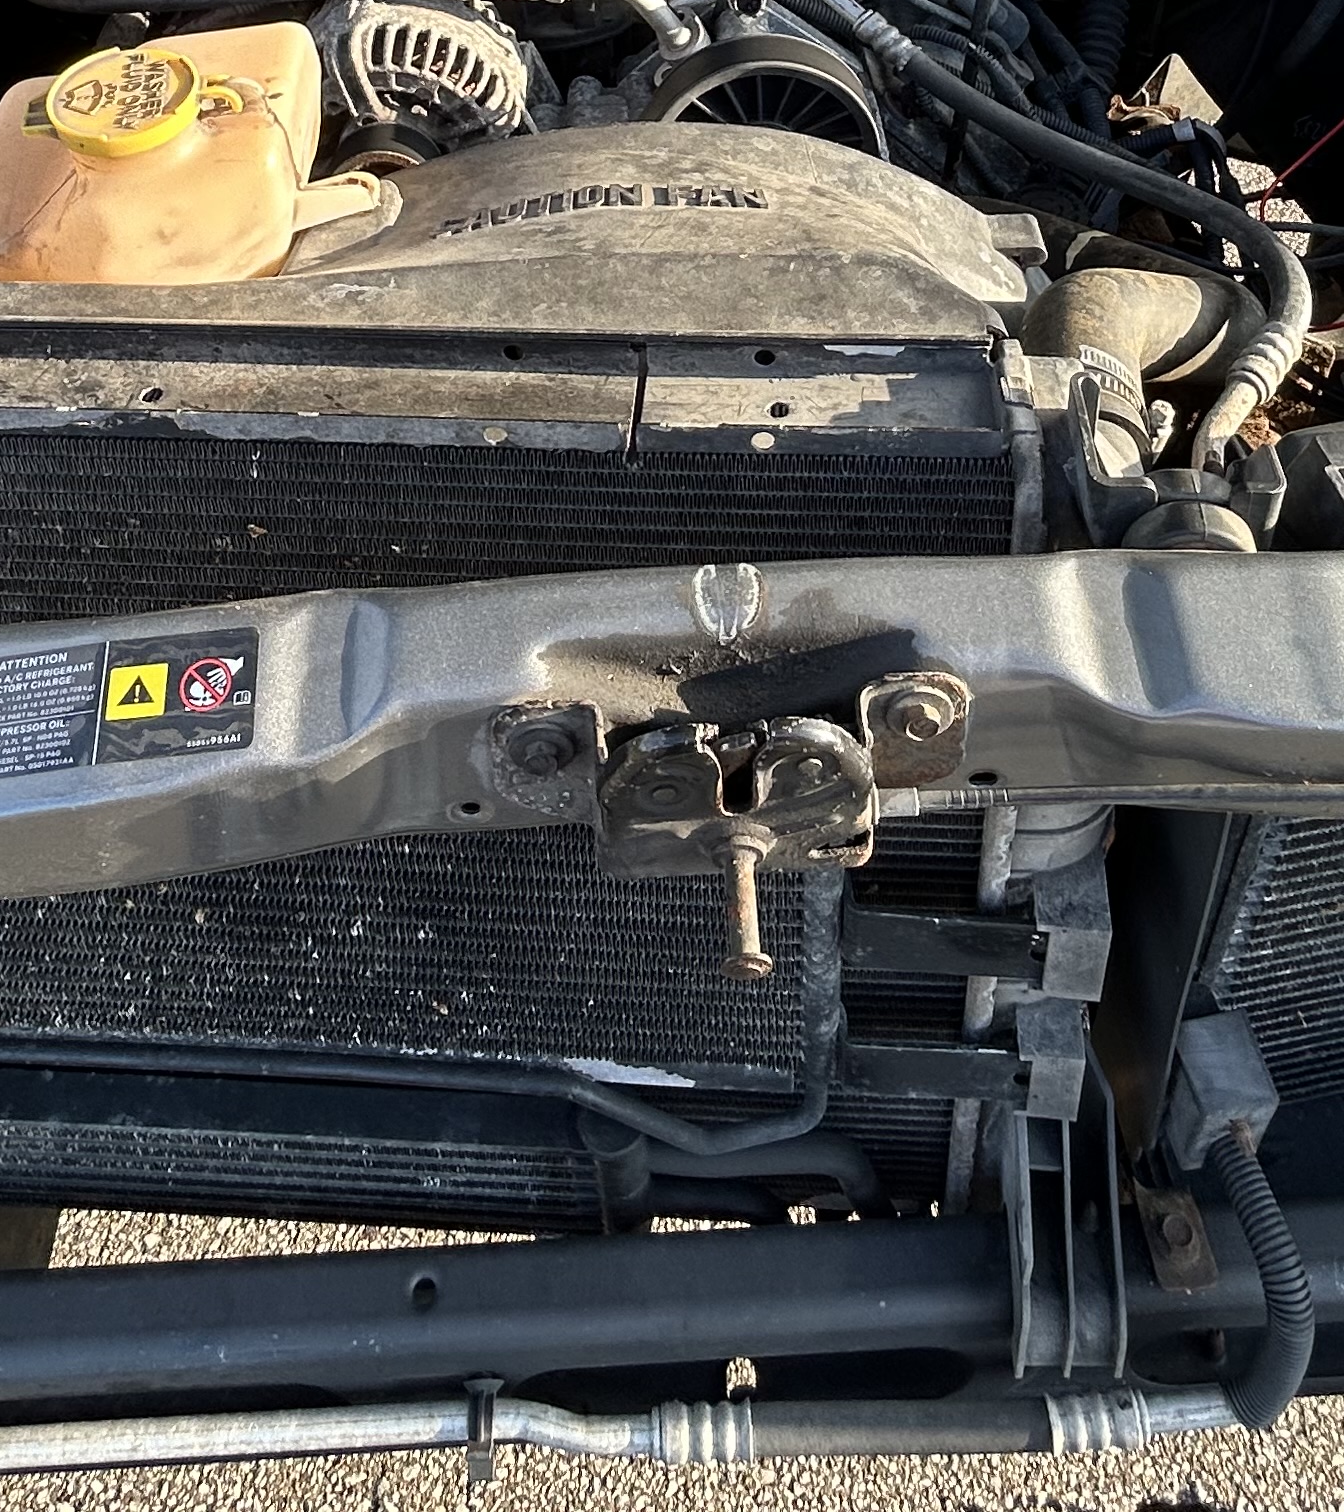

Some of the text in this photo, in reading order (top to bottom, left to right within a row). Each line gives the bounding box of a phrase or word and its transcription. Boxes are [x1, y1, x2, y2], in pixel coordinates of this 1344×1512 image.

[432, 183, 769, 238] CAUTION FAN
[3, 673, 24, 685] A/C
